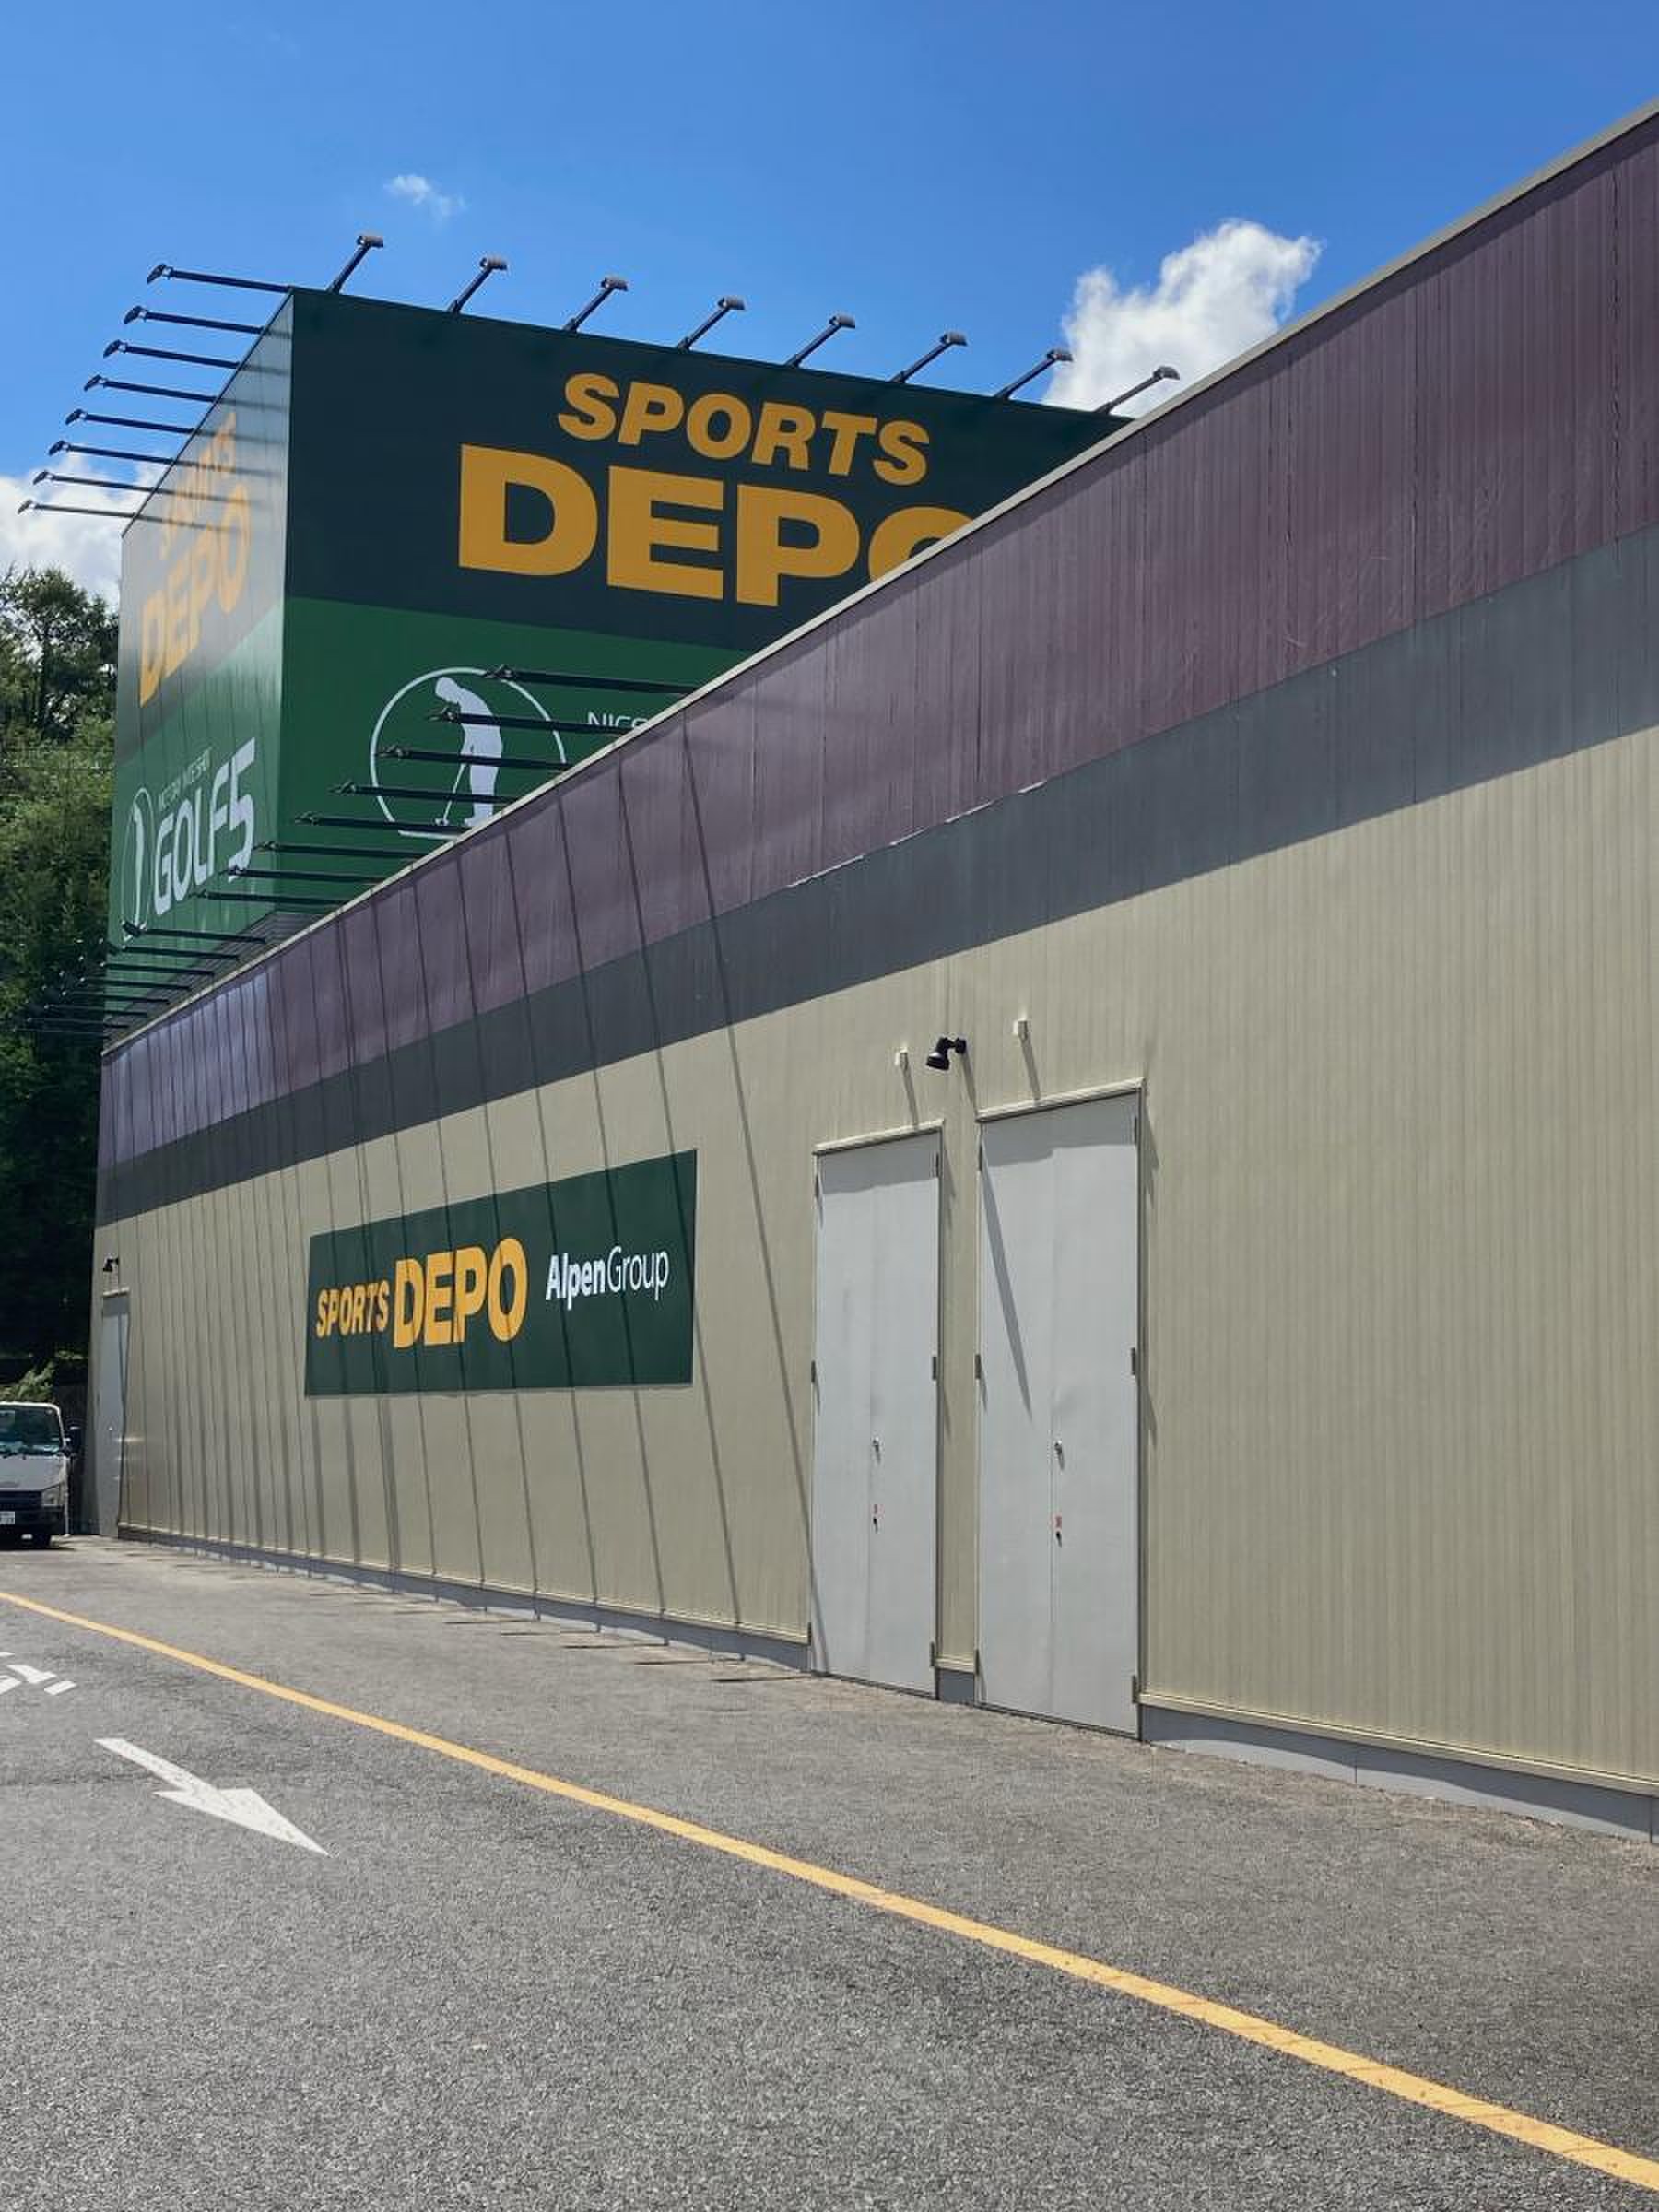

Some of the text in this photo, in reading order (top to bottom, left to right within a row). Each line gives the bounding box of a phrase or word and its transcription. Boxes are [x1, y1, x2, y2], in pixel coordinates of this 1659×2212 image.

[559, 373, 931, 485] SPORTS
[140, 483, 251, 707] DEPO
[315, 1280, 390, 1337] SPORTS
[394, 1237, 527, 1348] DEPO
